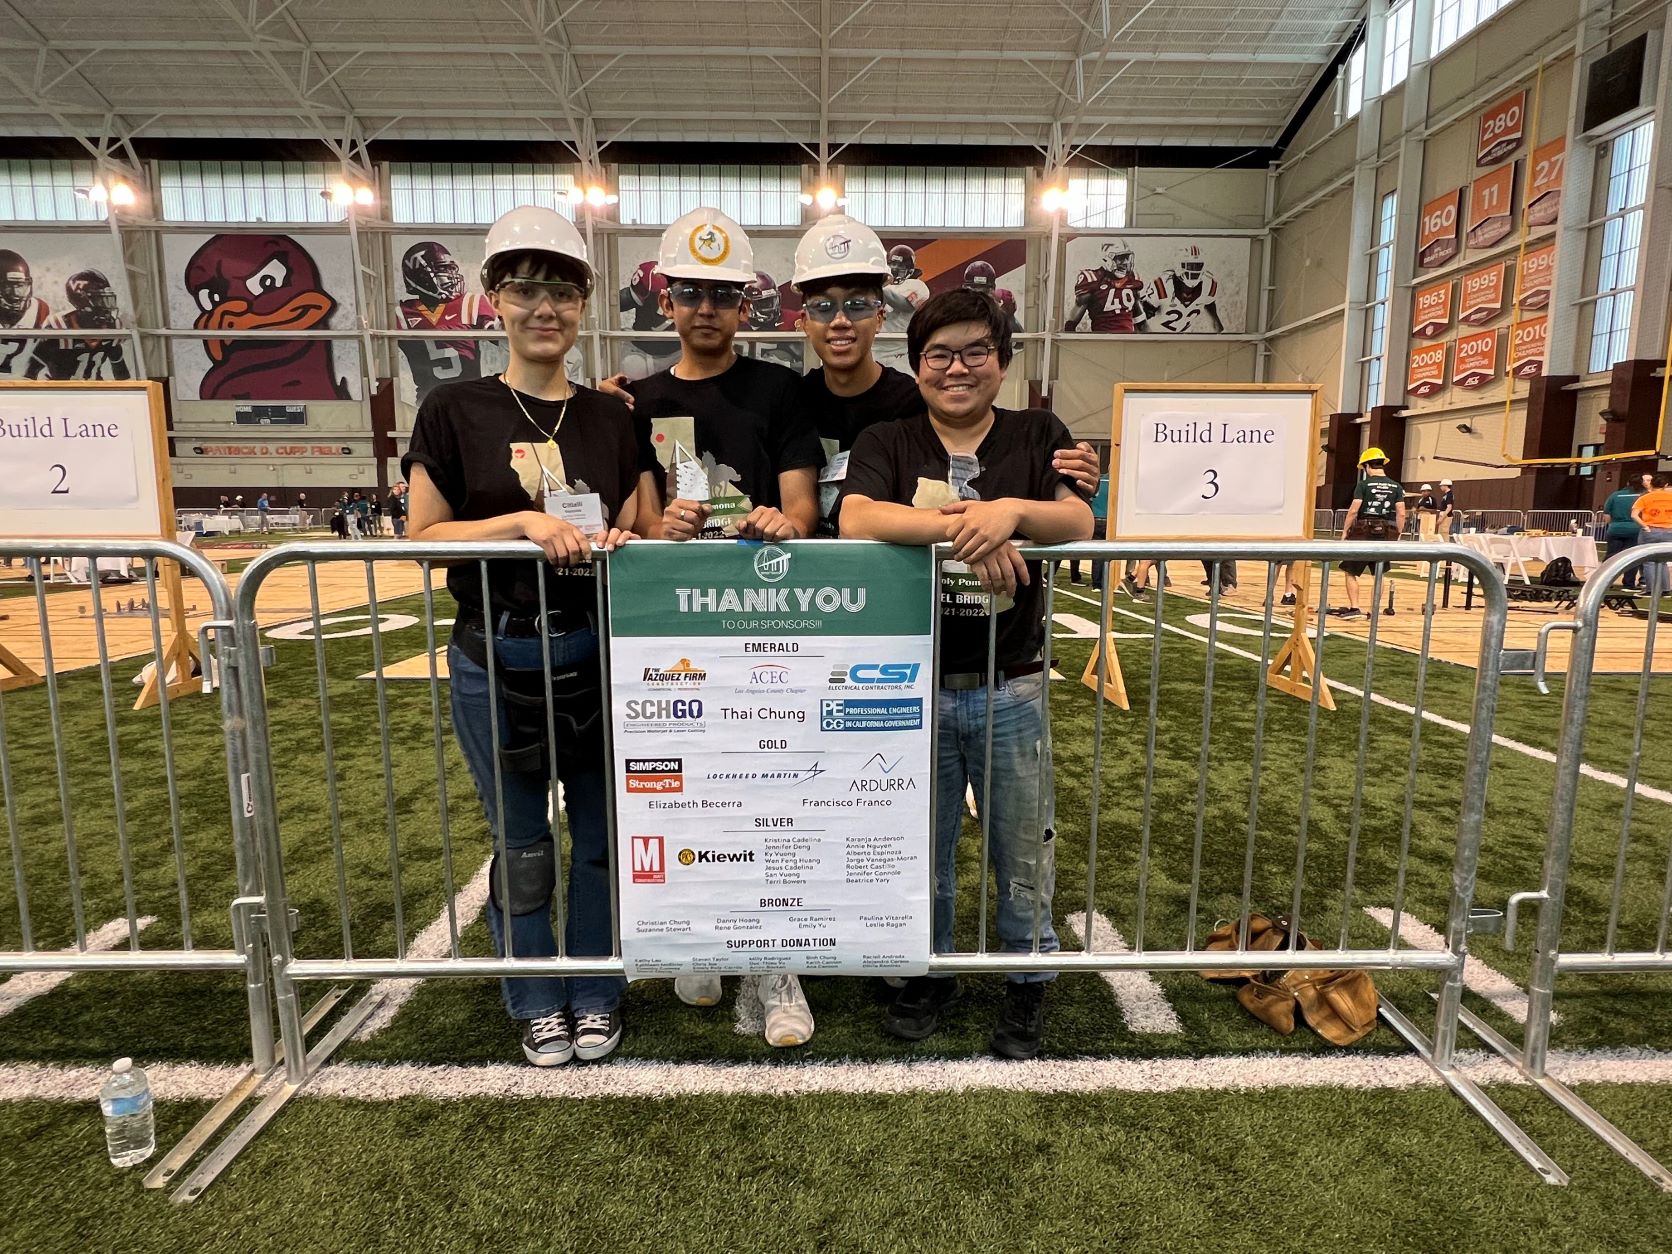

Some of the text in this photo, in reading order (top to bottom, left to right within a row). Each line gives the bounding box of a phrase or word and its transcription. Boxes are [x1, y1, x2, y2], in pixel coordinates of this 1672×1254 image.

[1483, 105, 1520, 141] 280
[1534, 152, 1565, 187] 27
[1482, 184, 1499, 209] 11
[1423, 204, 1456, 236] 160
[1466, 272, 1498, 294] 1995
[1103, 288, 1136, 315] 49
[1418, 288, 1446, 310] 1963
[1459, 337, 1492, 358] 2010
[1412, 350, 1442, 368] 2008
[62, 418, 119, 438] Lane
[1153, 422, 1275, 444] Build Lane
[204, 445, 345, 456] PATRICK D. CUPP FIEL
[48, 464, 70, 494] 2
[1201, 469, 1220, 500] 3
[712, 502, 736, 510] mona
[557, 568, 597, 576] 21-2022
[942, 578, 981, 586] oly Pom
[676, 586, 866, 613] THANK YOU
[956, 594, 990, 604] BRIDG
[941, 608, 985, 616] 21-2022
[722, 620, 736, 630] TO
[736, 620, 758, 630] OUR
[744, 642, 799, 653] EMERALD
[642, 668, 706, 682] VAZQUEZ FIRM
[750, 670, 789, 684] ACEC
[626, 700, 703, 720] SCHGO
[822, 700, 844, 716] PE
[888, 706, 920, 714] ENGINEERS
[720, 708, 806, 723] Thai Chung
[822, 718, 844, 730] CG
[884, 719, 920, 728] GOVERNMENT
[758, 740, 787, 750] GOLD
[630, 762, 678, 771] SIMPSON
[628, 778, 680, 790] Strong-Tie
[848, 778, 916, 792] ARDURRA
[648, 800, 742, 809] Elizabeth Becerra
[802, 798, 892, 806] Francisco Franco
[754, 818, 794, 828] SILVER
[633, 838, 660, 872] M
[698, 850, 755, 862] Kiewit
[760, 898, 804, 908] BRONZE
[726, 938, 836, 948] SUPPORT DONATION
